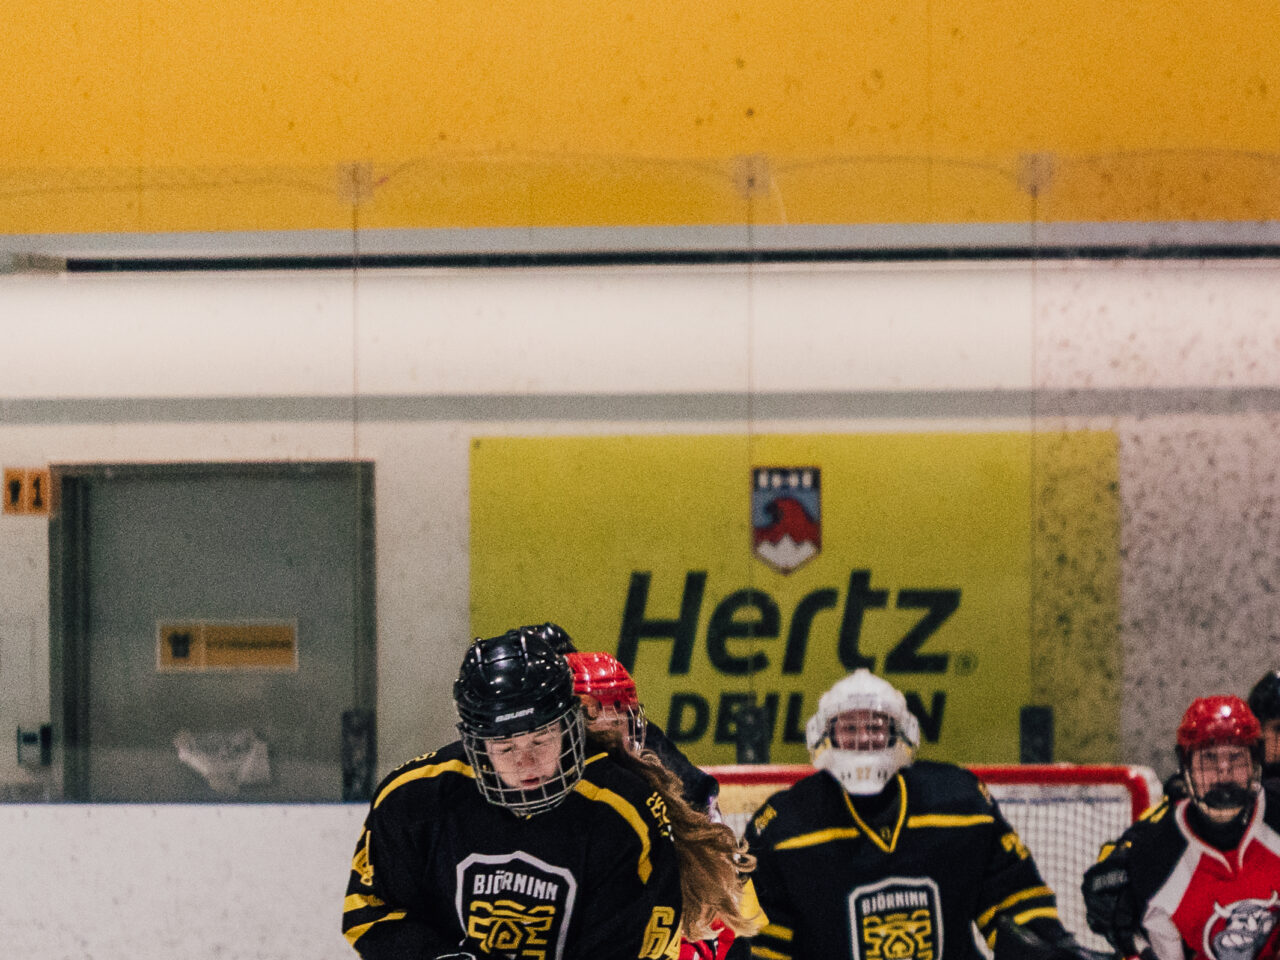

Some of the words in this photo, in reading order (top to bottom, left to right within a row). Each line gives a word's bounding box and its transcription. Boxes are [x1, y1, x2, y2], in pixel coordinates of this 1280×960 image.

[614, 569, 962, 676] Hertz
[665, 691, 947, 745] DEILN
[473, 869, 559, 901] BJÖRNINN
[862, 890, 928, 916] BJÖRNINN
